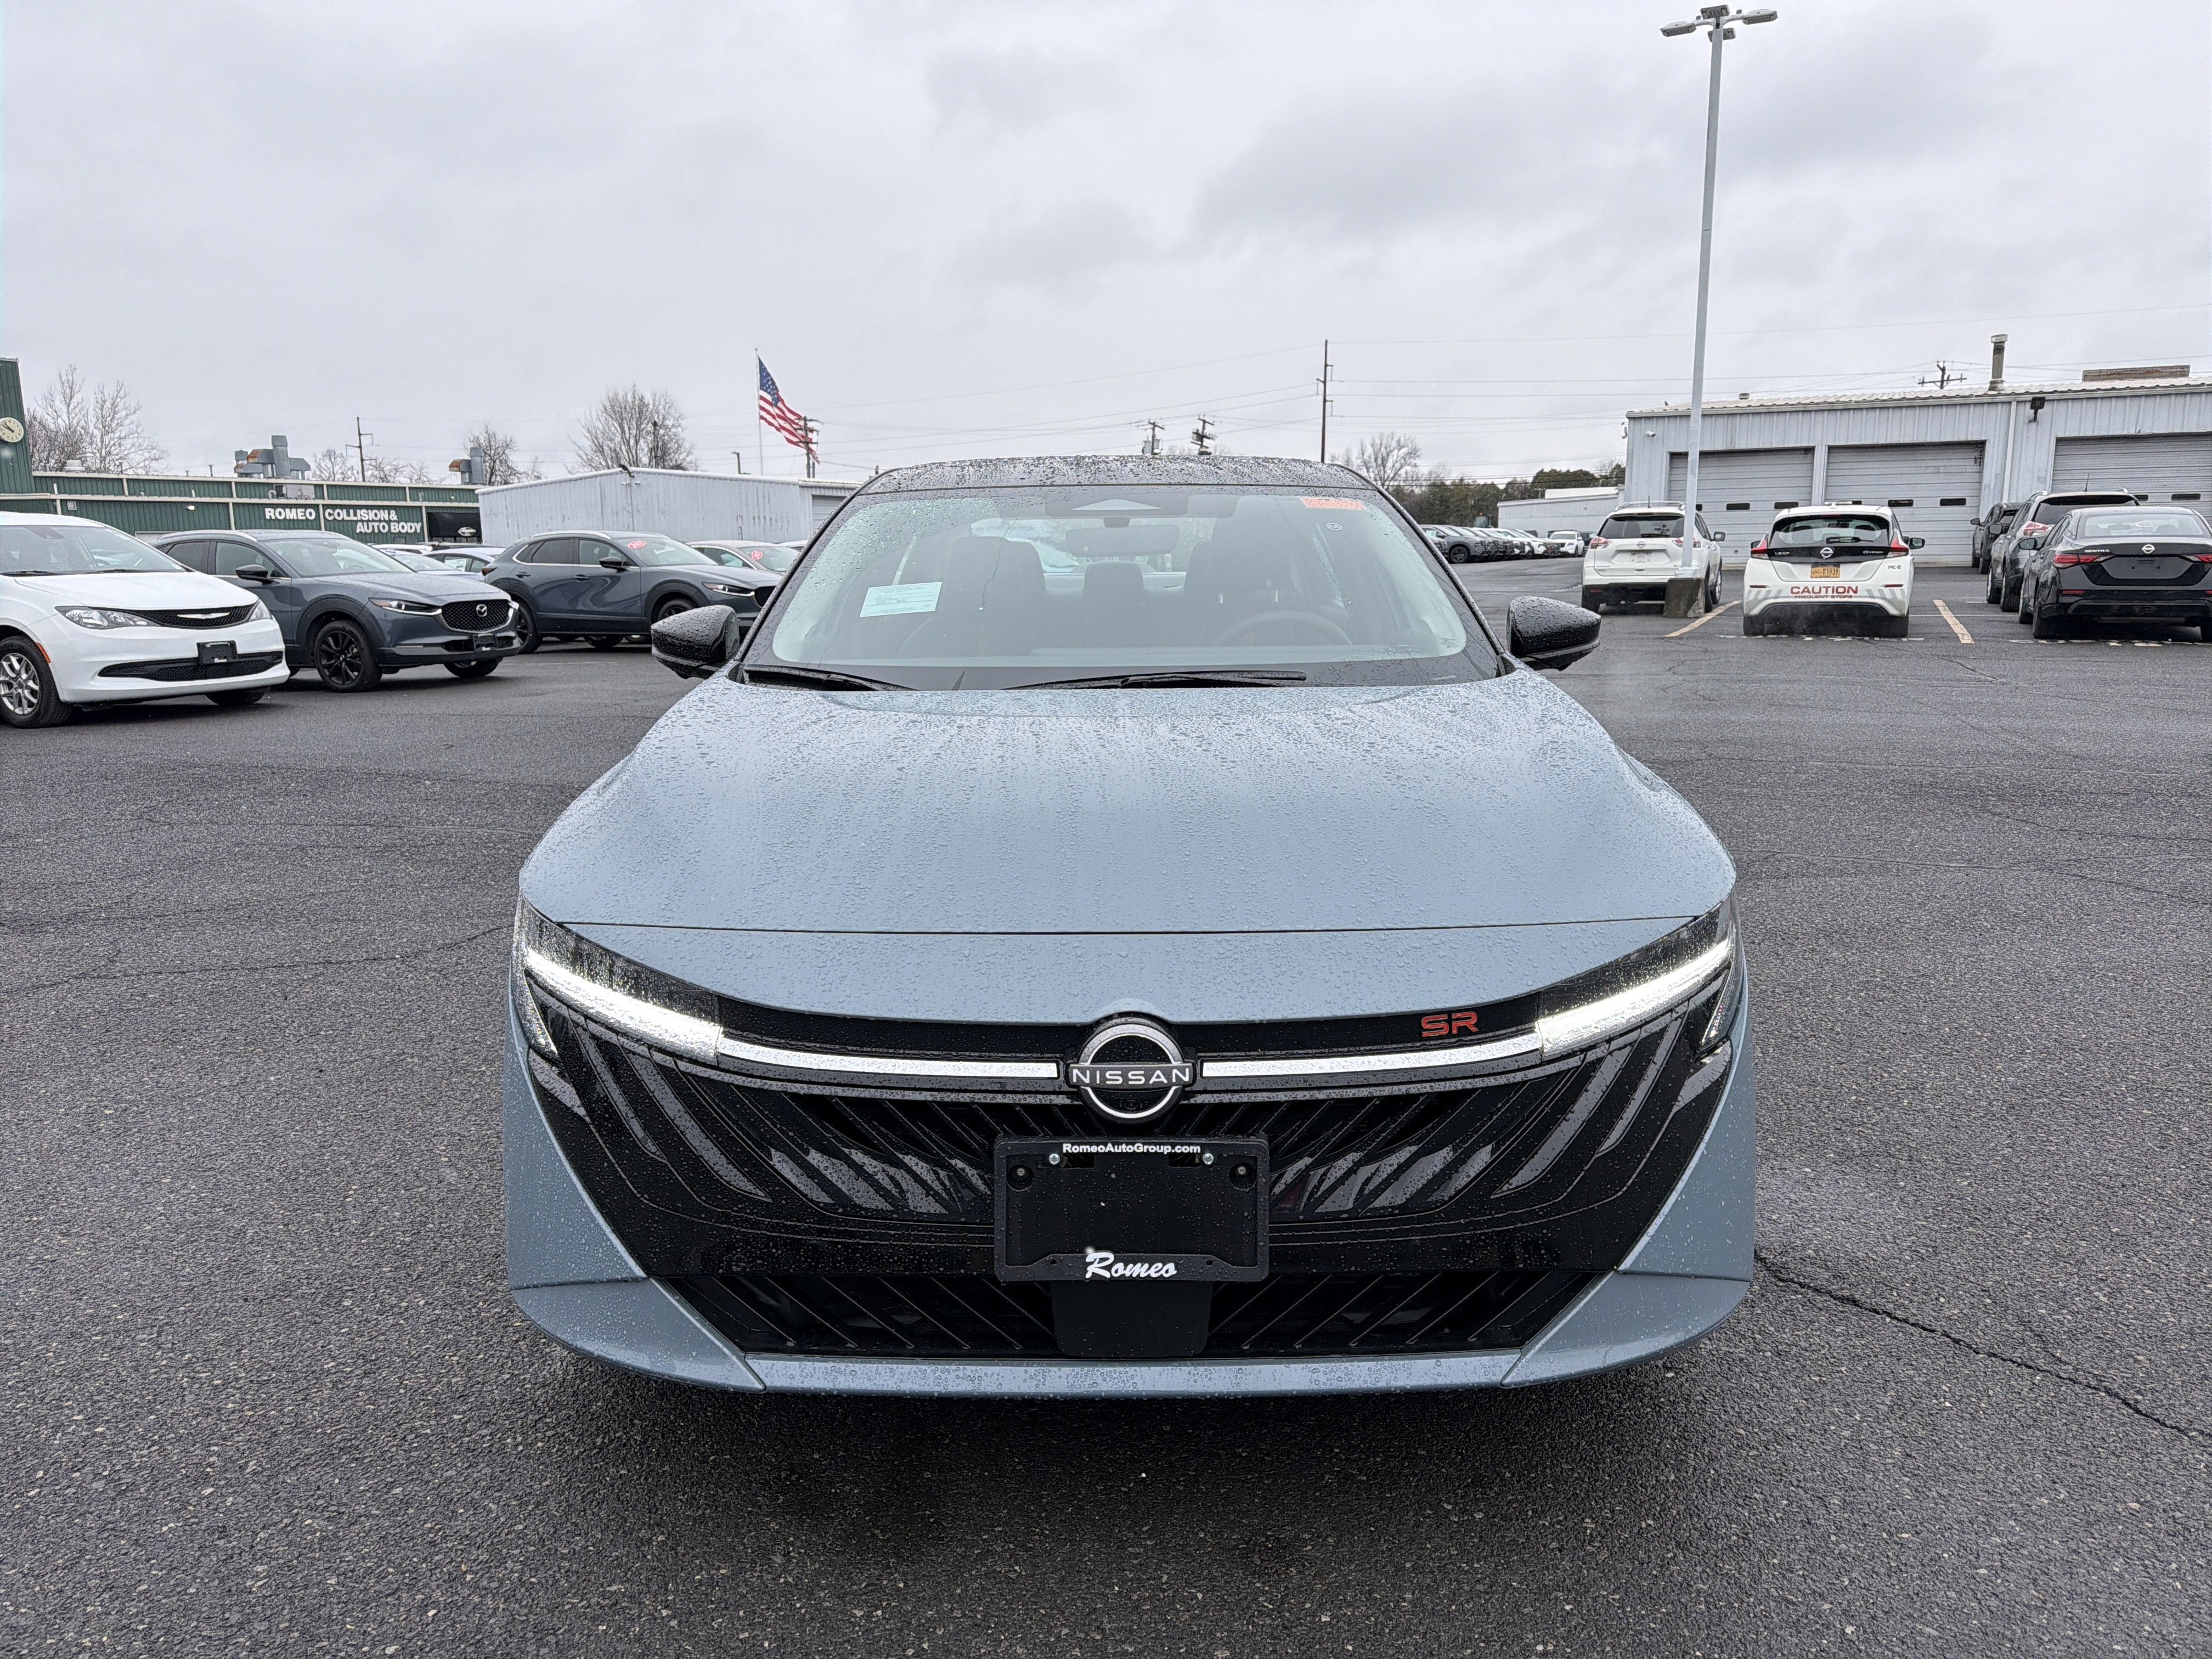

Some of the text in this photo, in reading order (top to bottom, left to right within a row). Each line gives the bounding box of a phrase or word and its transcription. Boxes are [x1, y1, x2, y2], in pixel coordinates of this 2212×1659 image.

[265, 507, 316, 520] ROMEO
[325, 509, 388, 521] COLLISION
[356, 522, 422, 533] AUTO BODY
[1790, 585, 1859, 595] CAUTION
[1421, 1011, 1479, 1037] SR
[1073, 1068, 1189, 1085] NISSAN
[1063, 1143, 1201, 1155] RomeoAutoGroup.com
[1085, 1252, 1177, 1279] Romeo
